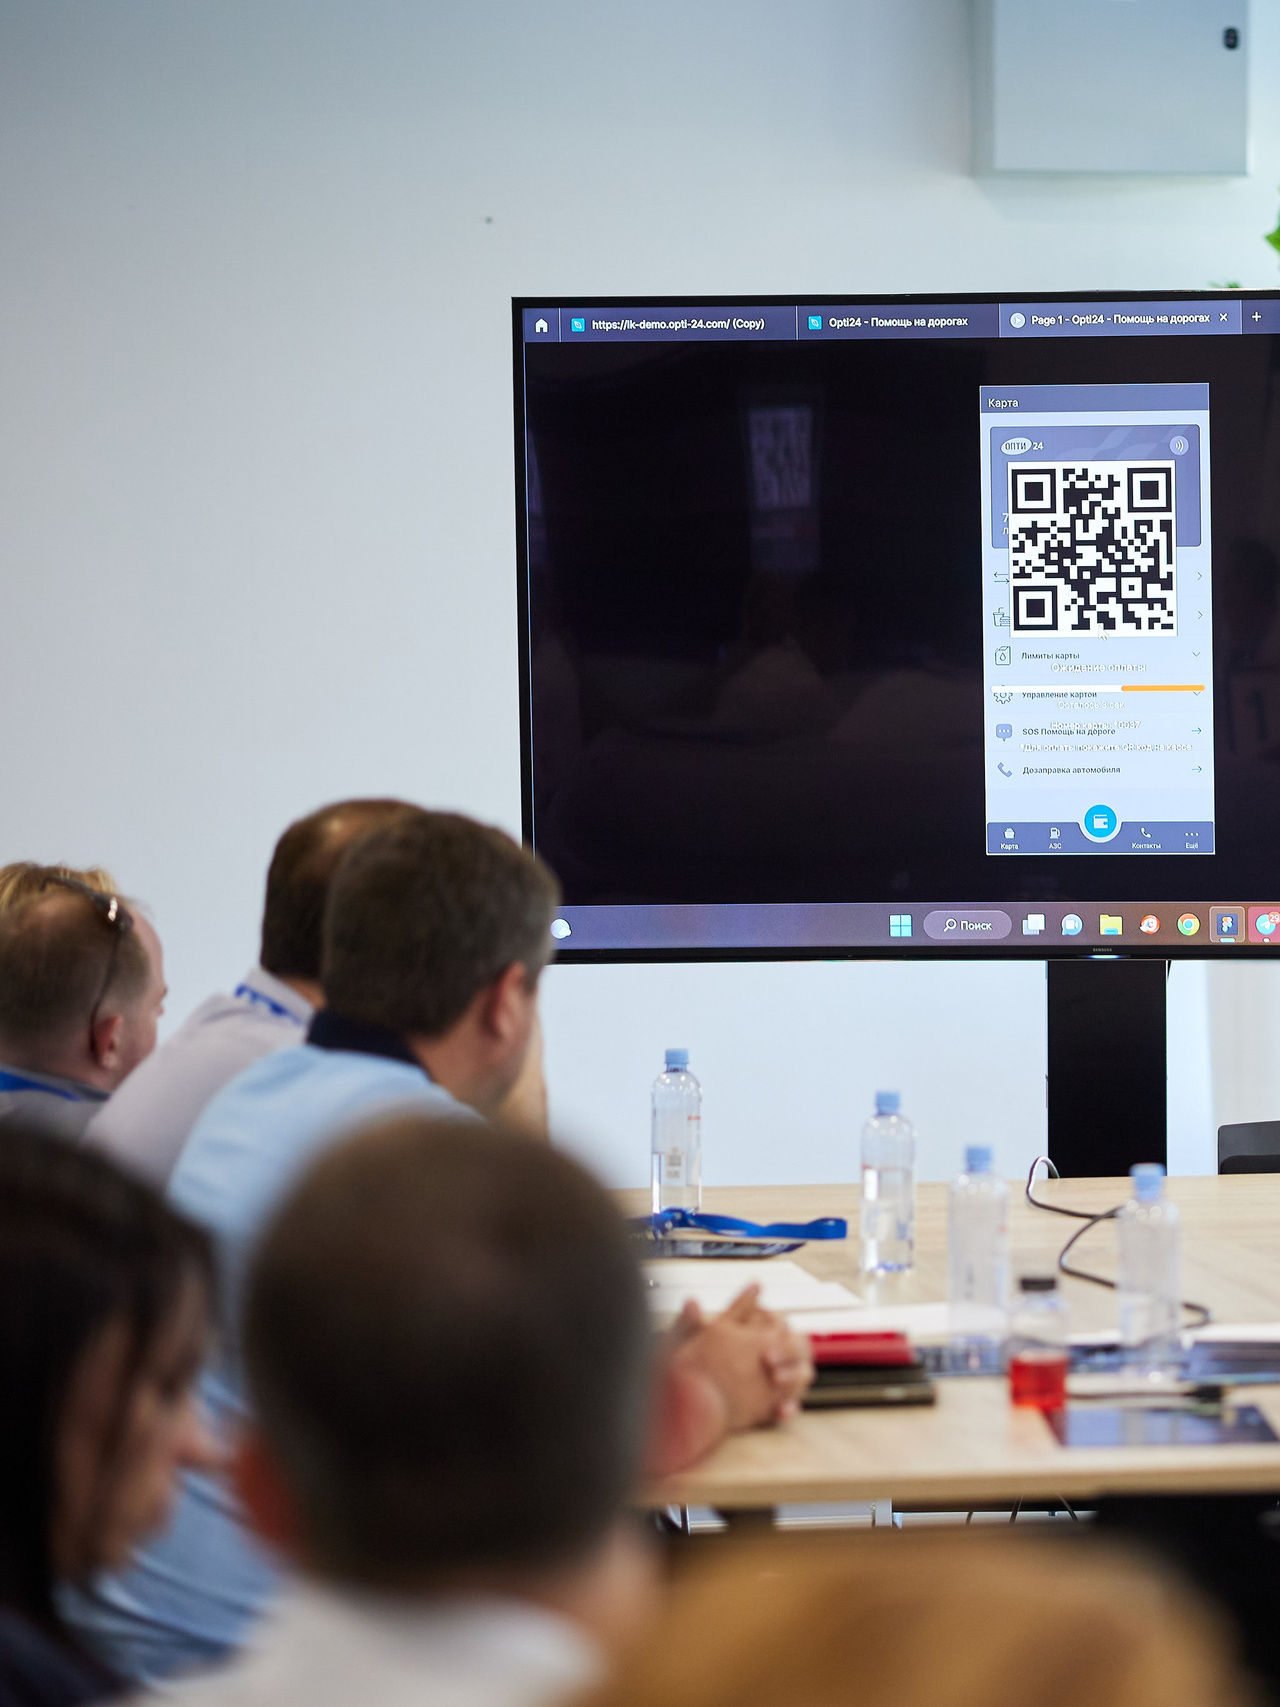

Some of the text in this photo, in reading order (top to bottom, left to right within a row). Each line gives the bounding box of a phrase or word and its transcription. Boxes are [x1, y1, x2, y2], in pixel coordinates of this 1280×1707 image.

[592, 318, 765, 331] https://lk-demo.opti-24.com/ (Copy)
[829, 317, 862, 329] Opti24
[871, 317, 912, 328] Помощь
[914, 318, 926, 326] на
[928, 317, 968, 328] дорогах
[1031, 315, 1056, 327] Page
[1058, 316, 1063, 325] 1
[1072, 315, 1105, 326] Opti24
[1113, 314, 1154, 325] Помощь
[1157, 315, 1169, 323] на
[1170, 314, 1210, 325] дорогах
[988, 398, 1019, 409] Карта
[1033, 441, 1043, 451] 24
[1056, 653, 1080, 661] карты
[1051, 663, 1147, 674] Ожидание оплаты
[1041, 728, 1074, 736] Помощь
[1087, 727, 1116, 736] дороге
[1122, 743, 1135, 751] QR
[1022, 766, 1121, 775] Дозаправка автомобиля
[1001, 842, 1018, 850] Карта
[961, 919, 992, 931] Поиск
